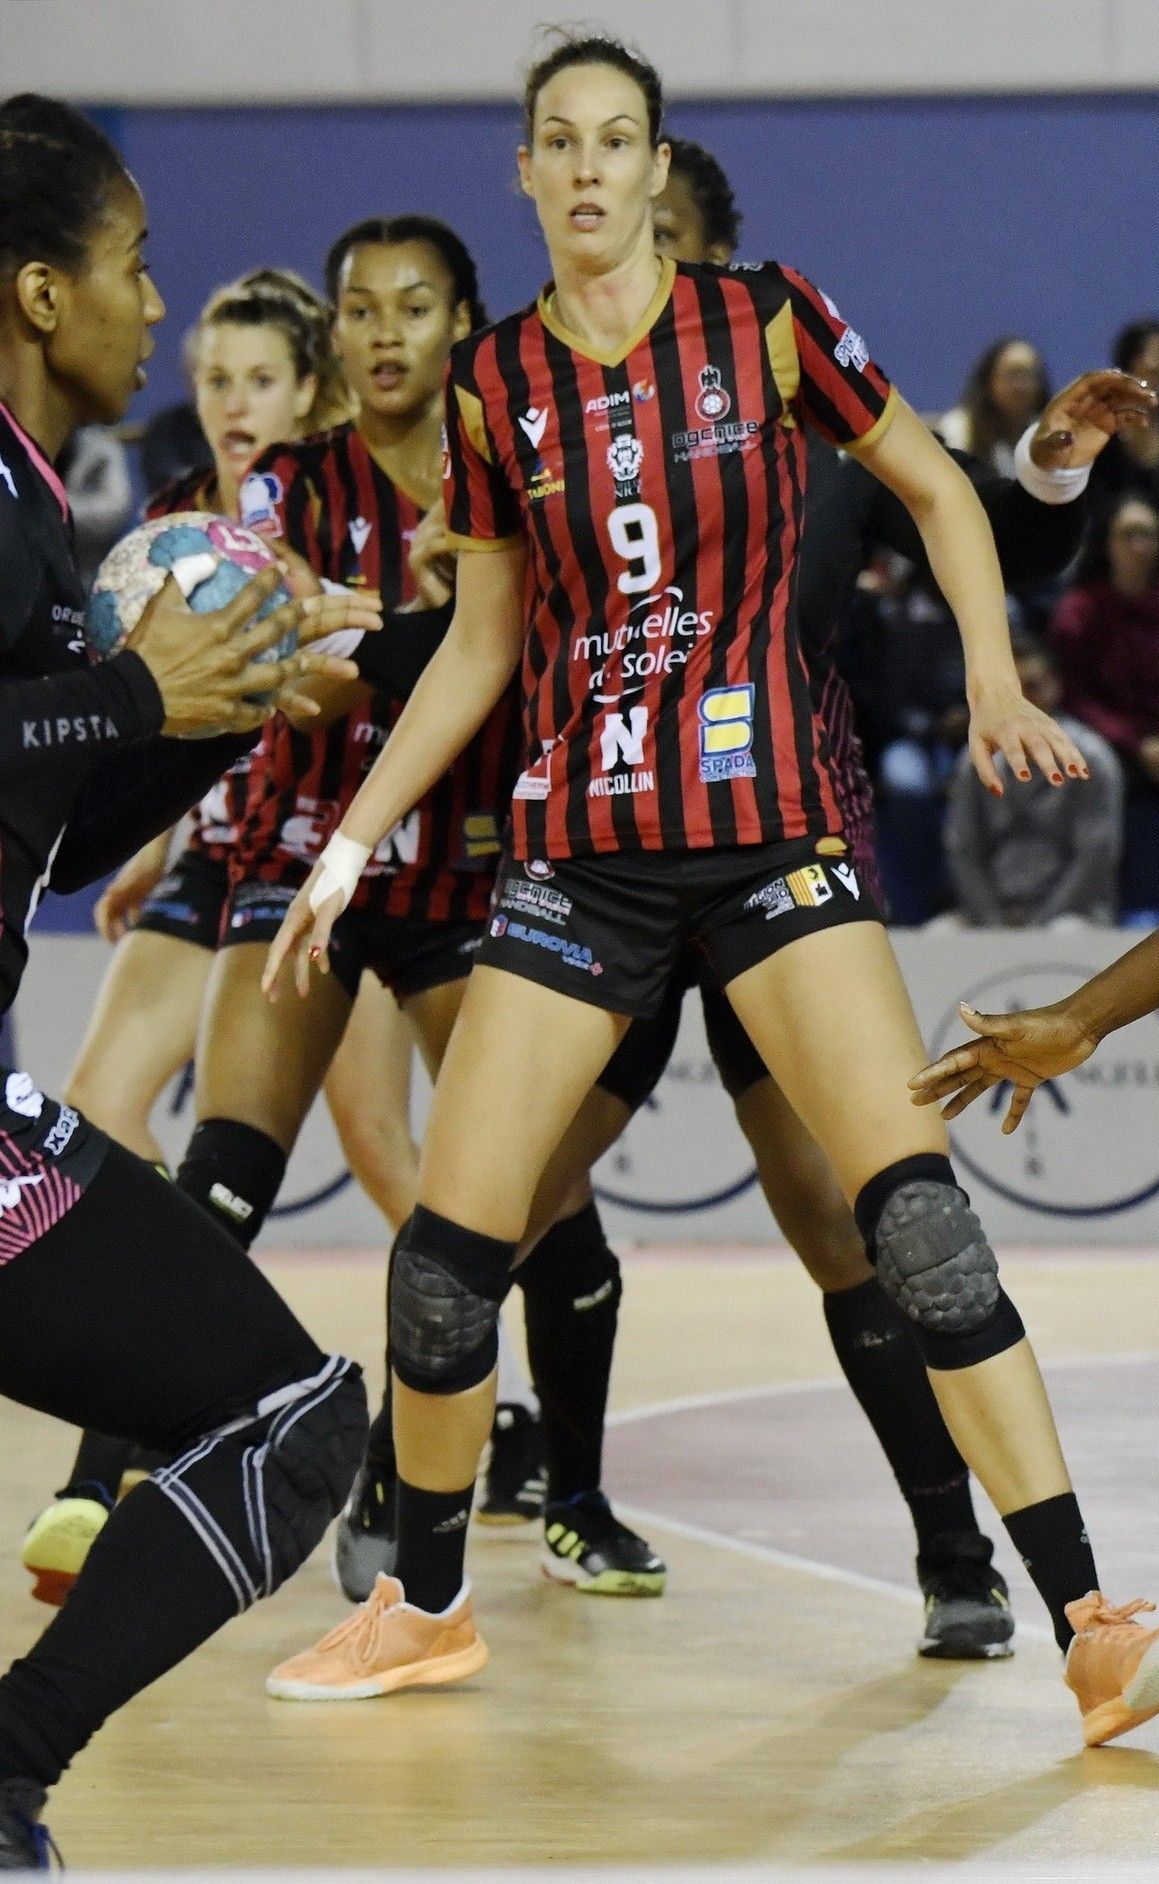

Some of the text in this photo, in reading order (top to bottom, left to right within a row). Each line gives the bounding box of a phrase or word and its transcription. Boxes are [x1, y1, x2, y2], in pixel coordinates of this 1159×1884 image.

[586, 391, 630, 413] ADIM
[607, 502, 662, 594] 9
[22, 714, 119, 749] KIPSTA
[601, 705, 648, 771] N
[701, 753, 756, 774] SPADA
[588, 771, 654, 798] NICOLLIN
